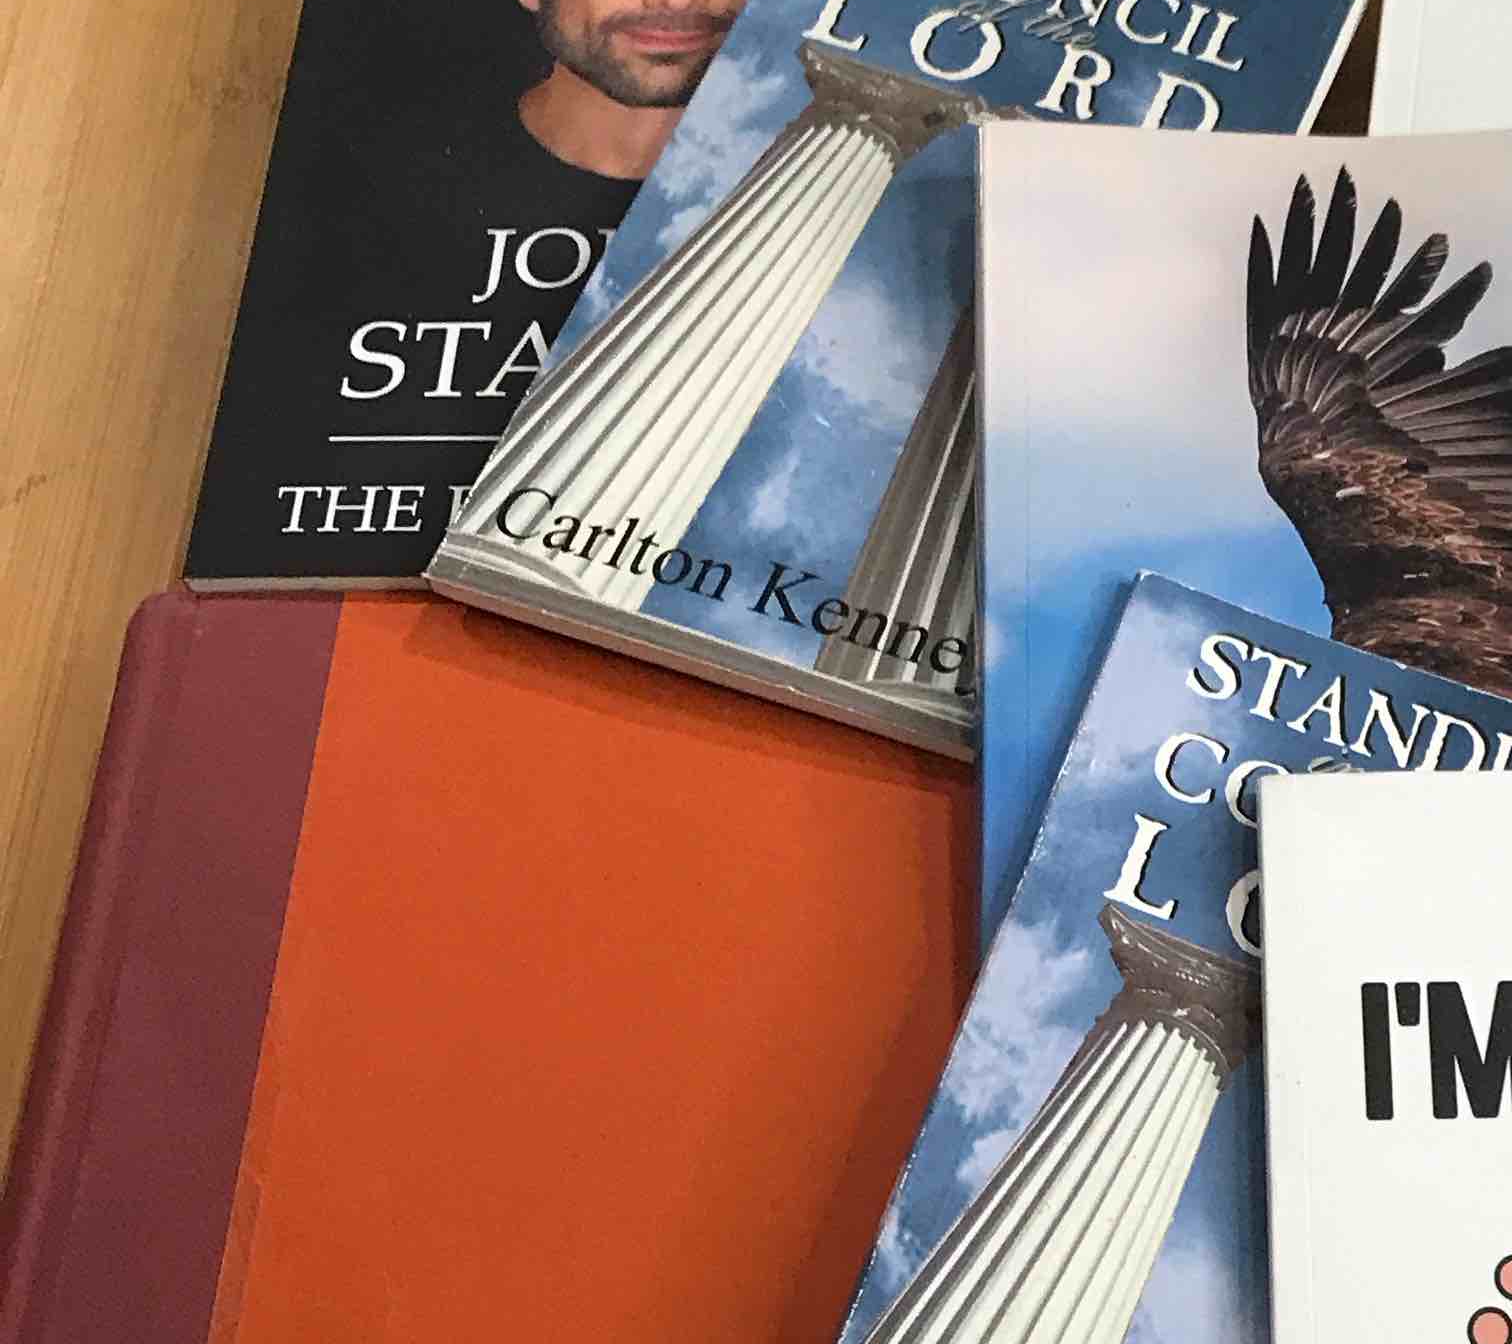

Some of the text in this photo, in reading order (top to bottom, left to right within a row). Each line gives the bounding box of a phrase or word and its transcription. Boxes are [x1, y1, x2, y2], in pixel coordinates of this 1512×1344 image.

[472, 227, 614, 304] JO
[278, 485, 424, 534] THE
[495, 489, 733, 601] Carlton
